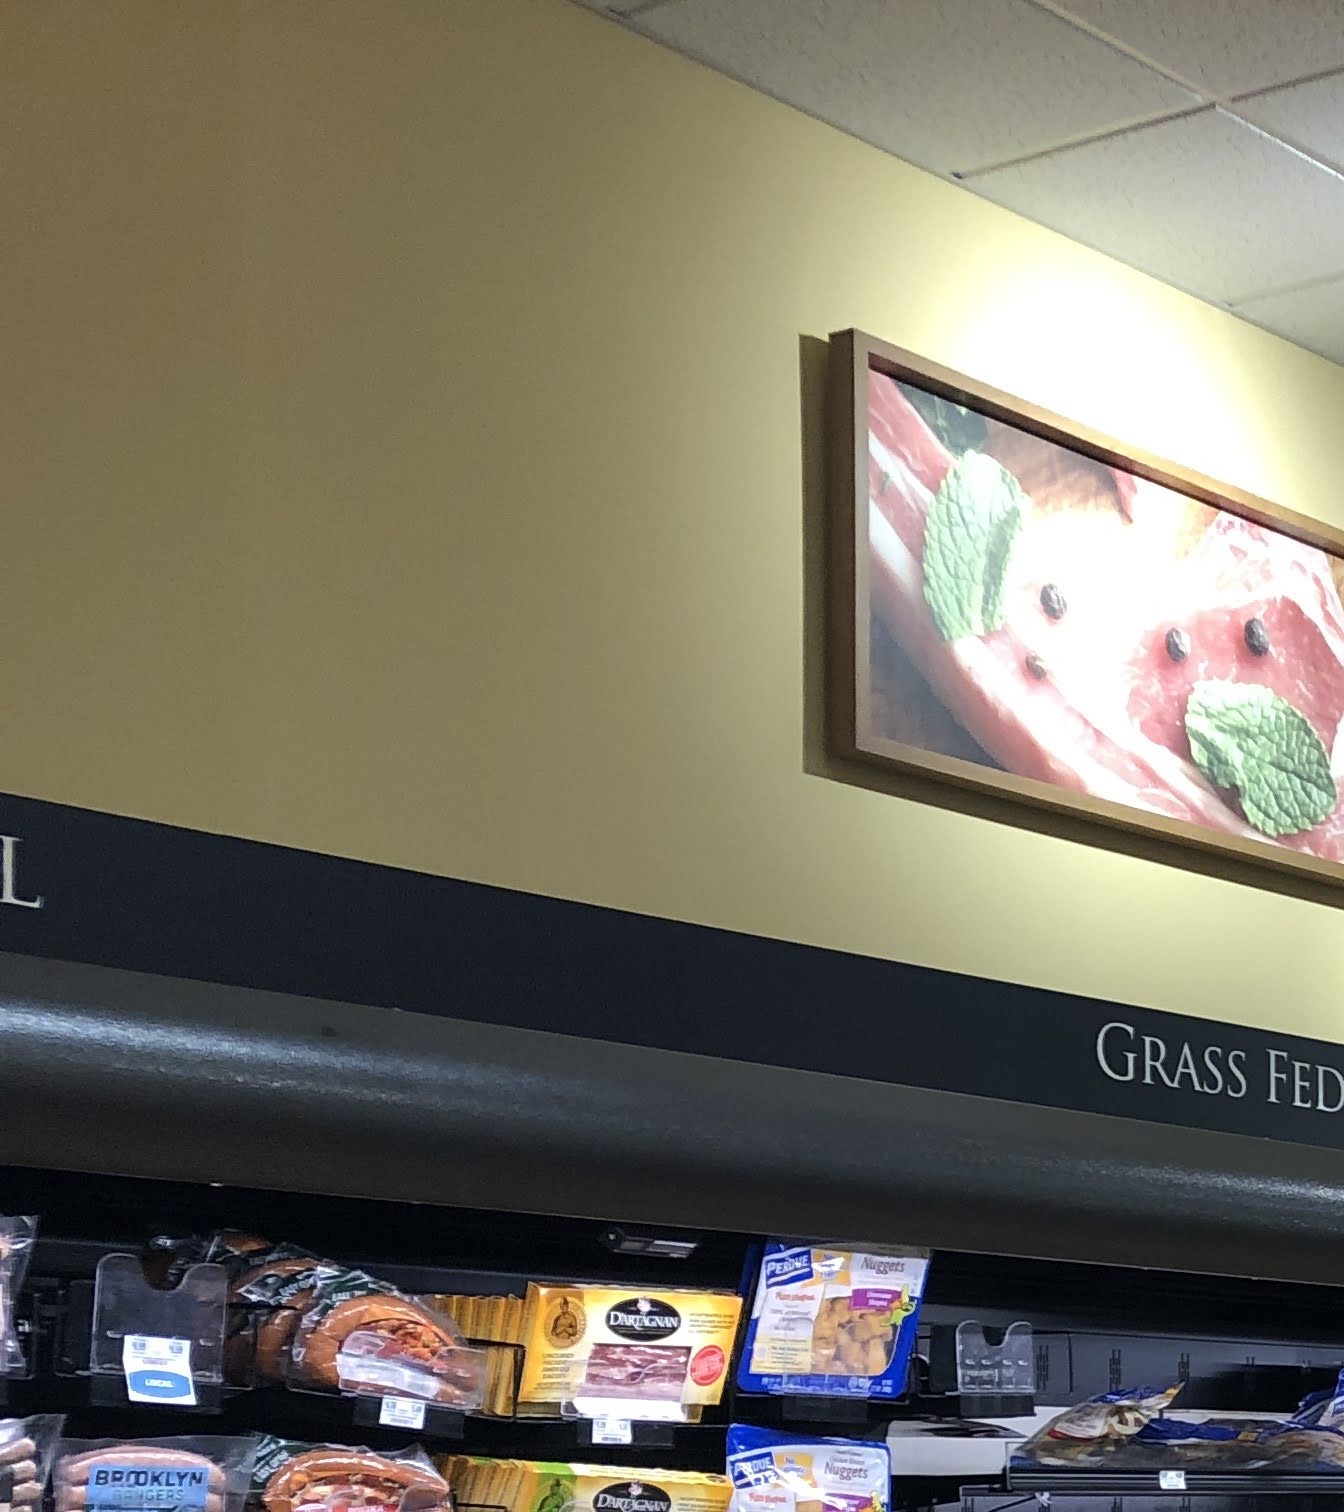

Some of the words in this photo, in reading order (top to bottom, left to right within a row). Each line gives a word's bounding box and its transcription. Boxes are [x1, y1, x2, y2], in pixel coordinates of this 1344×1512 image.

[766, 1255, 809, 1276] PERDUE
[861, 1257, 905, 1275] Nuggets
[95, 1469, 204, 1487] BROOKLYN
[824, 1462, 868, 1480] Nuggets
